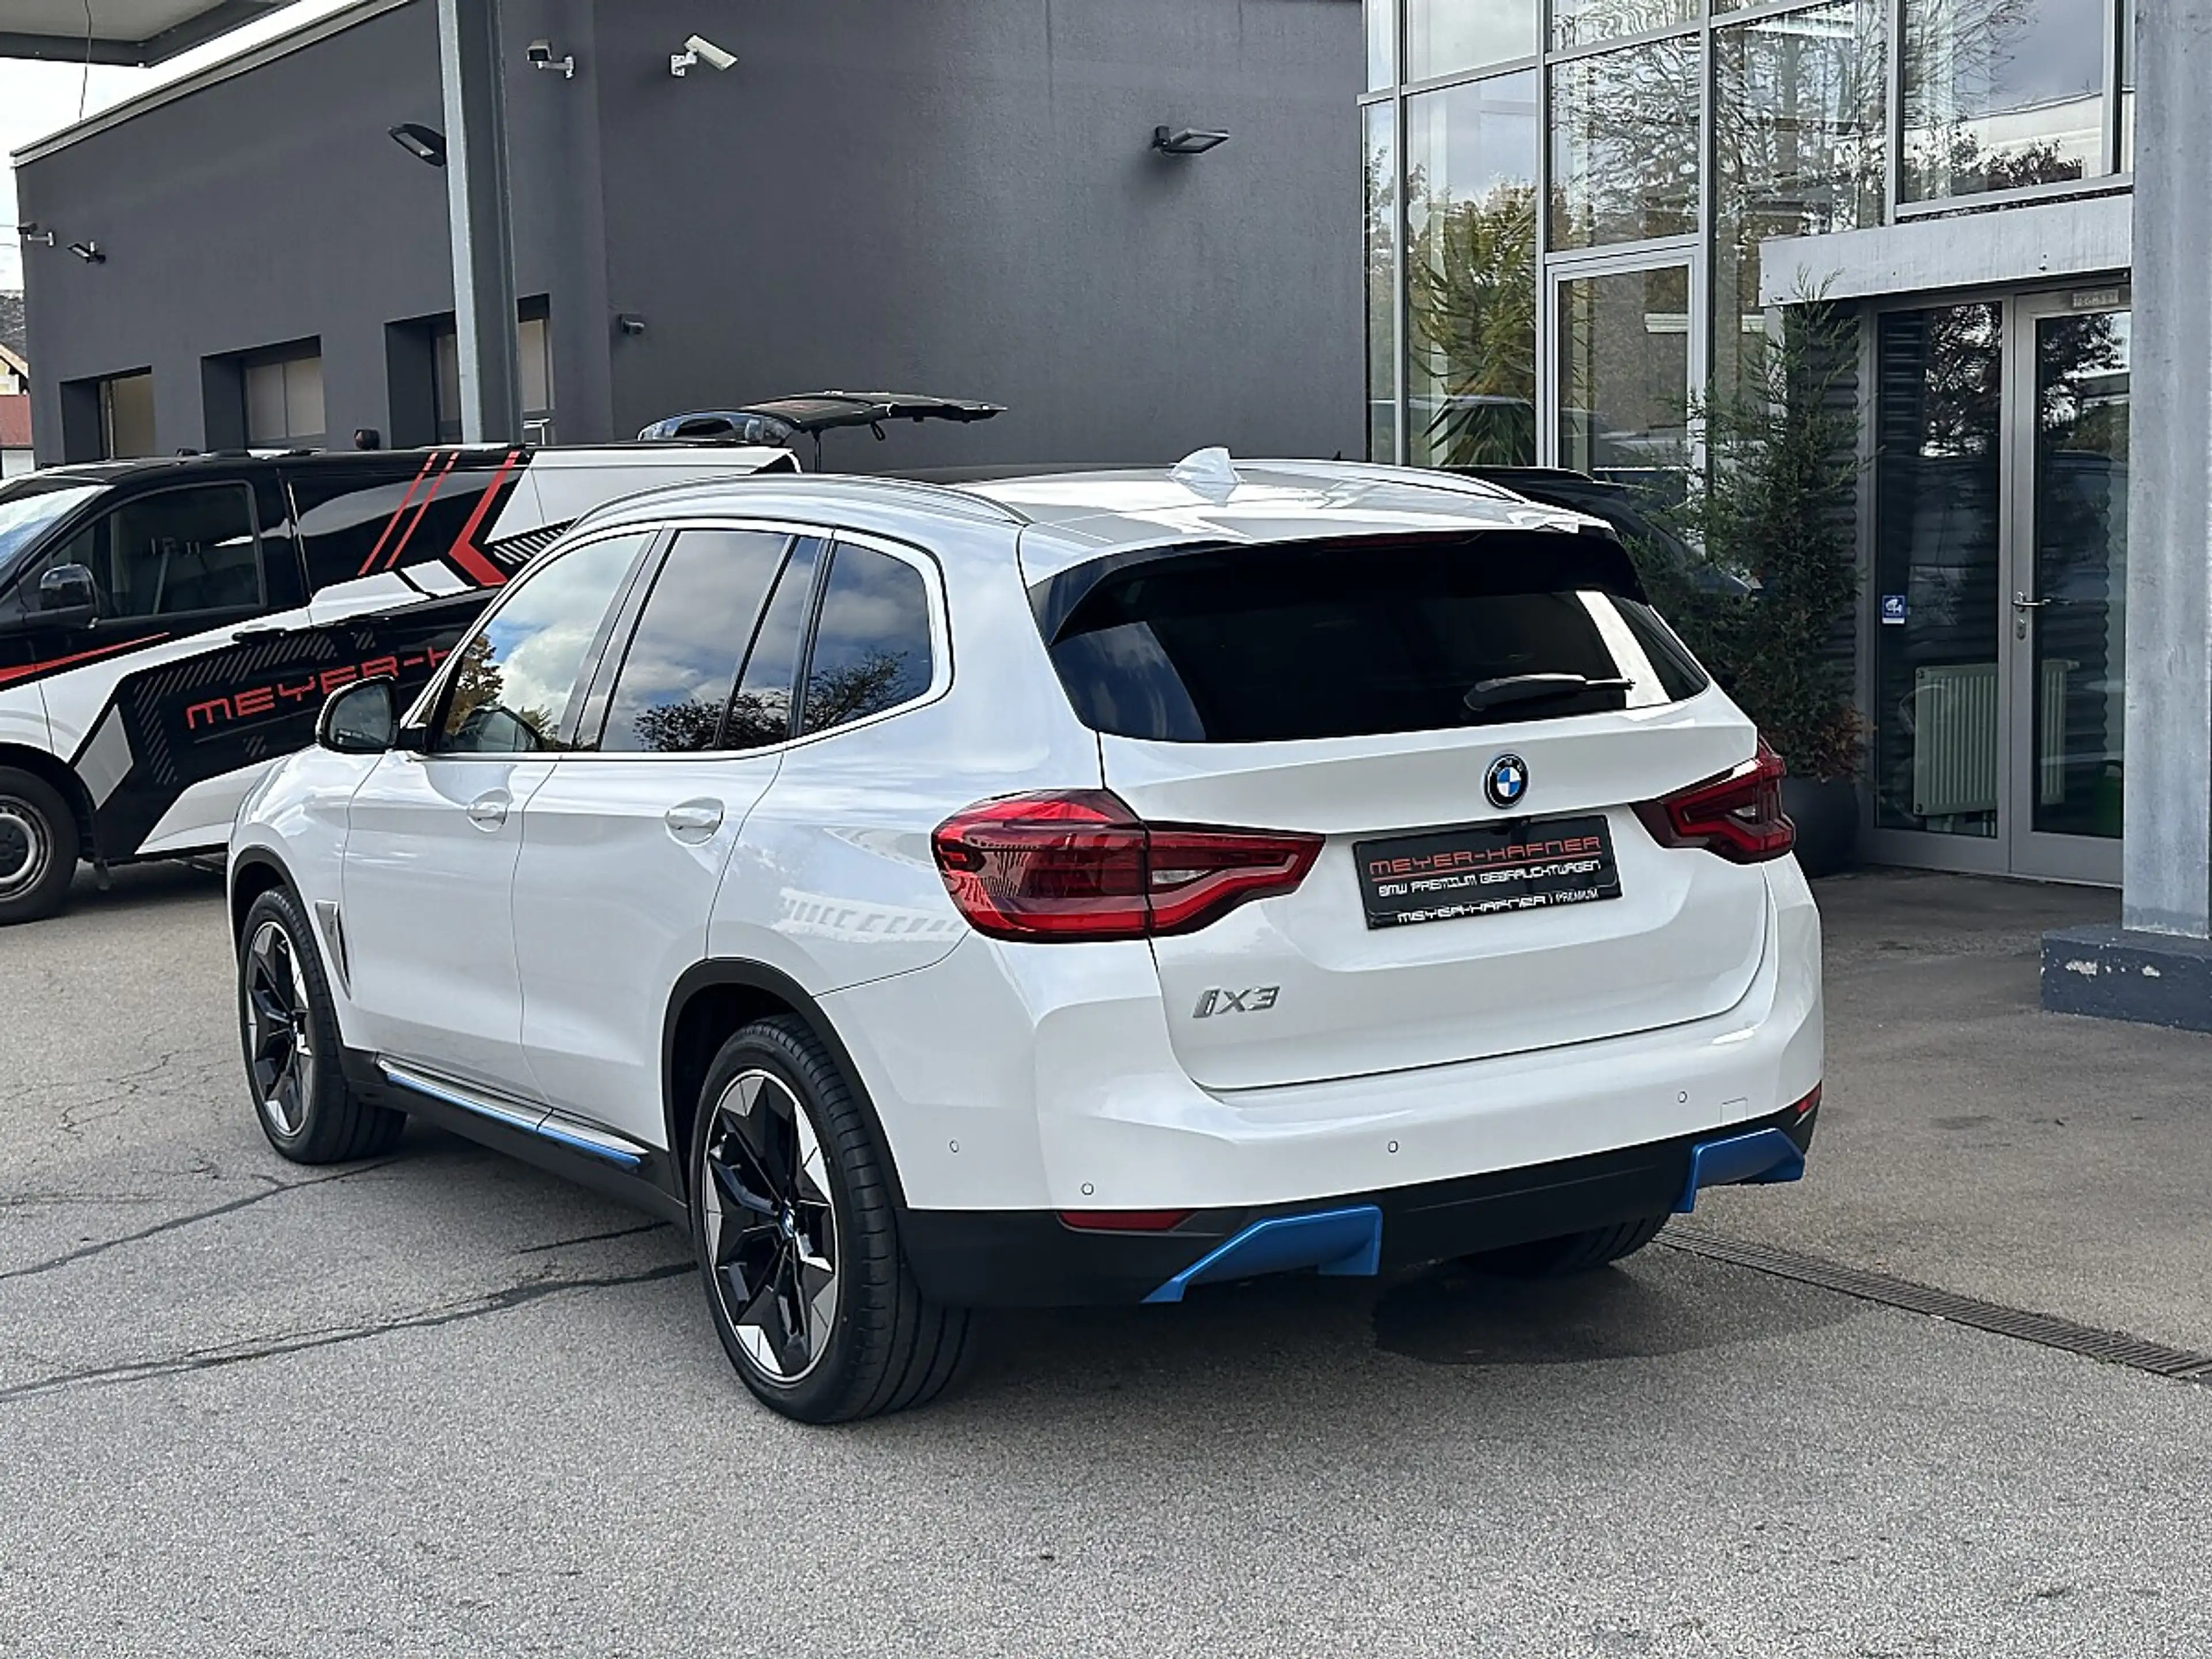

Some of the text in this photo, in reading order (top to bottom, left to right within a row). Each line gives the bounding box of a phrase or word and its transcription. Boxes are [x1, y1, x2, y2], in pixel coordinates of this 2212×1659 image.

[1369, 836, 1601, 875] MEYER-HAFNER
[1378, 859, 1601, 897] BMW PREMIUM GEBRAUCHTWAGEN
[1397, 895, 1546, 923] MEYER-HAFNER
[1192, 986, 1281, 1018] iX3
